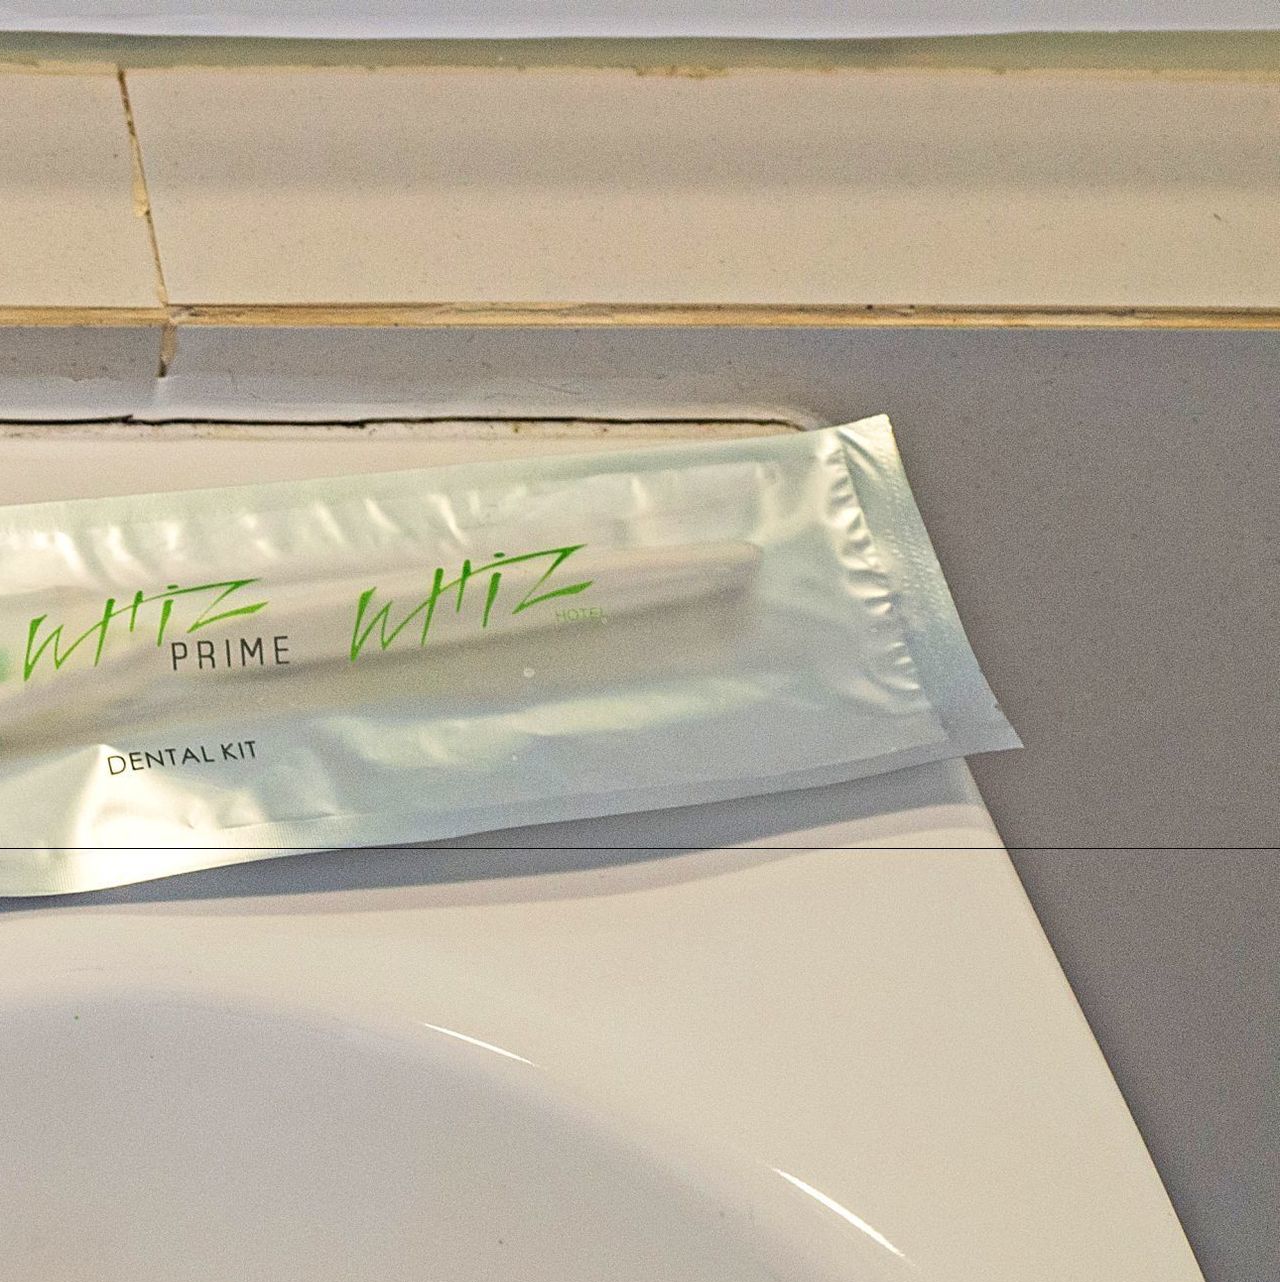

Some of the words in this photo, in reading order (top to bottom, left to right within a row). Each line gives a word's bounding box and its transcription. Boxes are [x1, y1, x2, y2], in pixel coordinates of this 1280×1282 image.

[170, 635, 291, 672] PRIME
[107, 742, 215, 777] DENTAL
[221, 740, 258, 761] KIT
